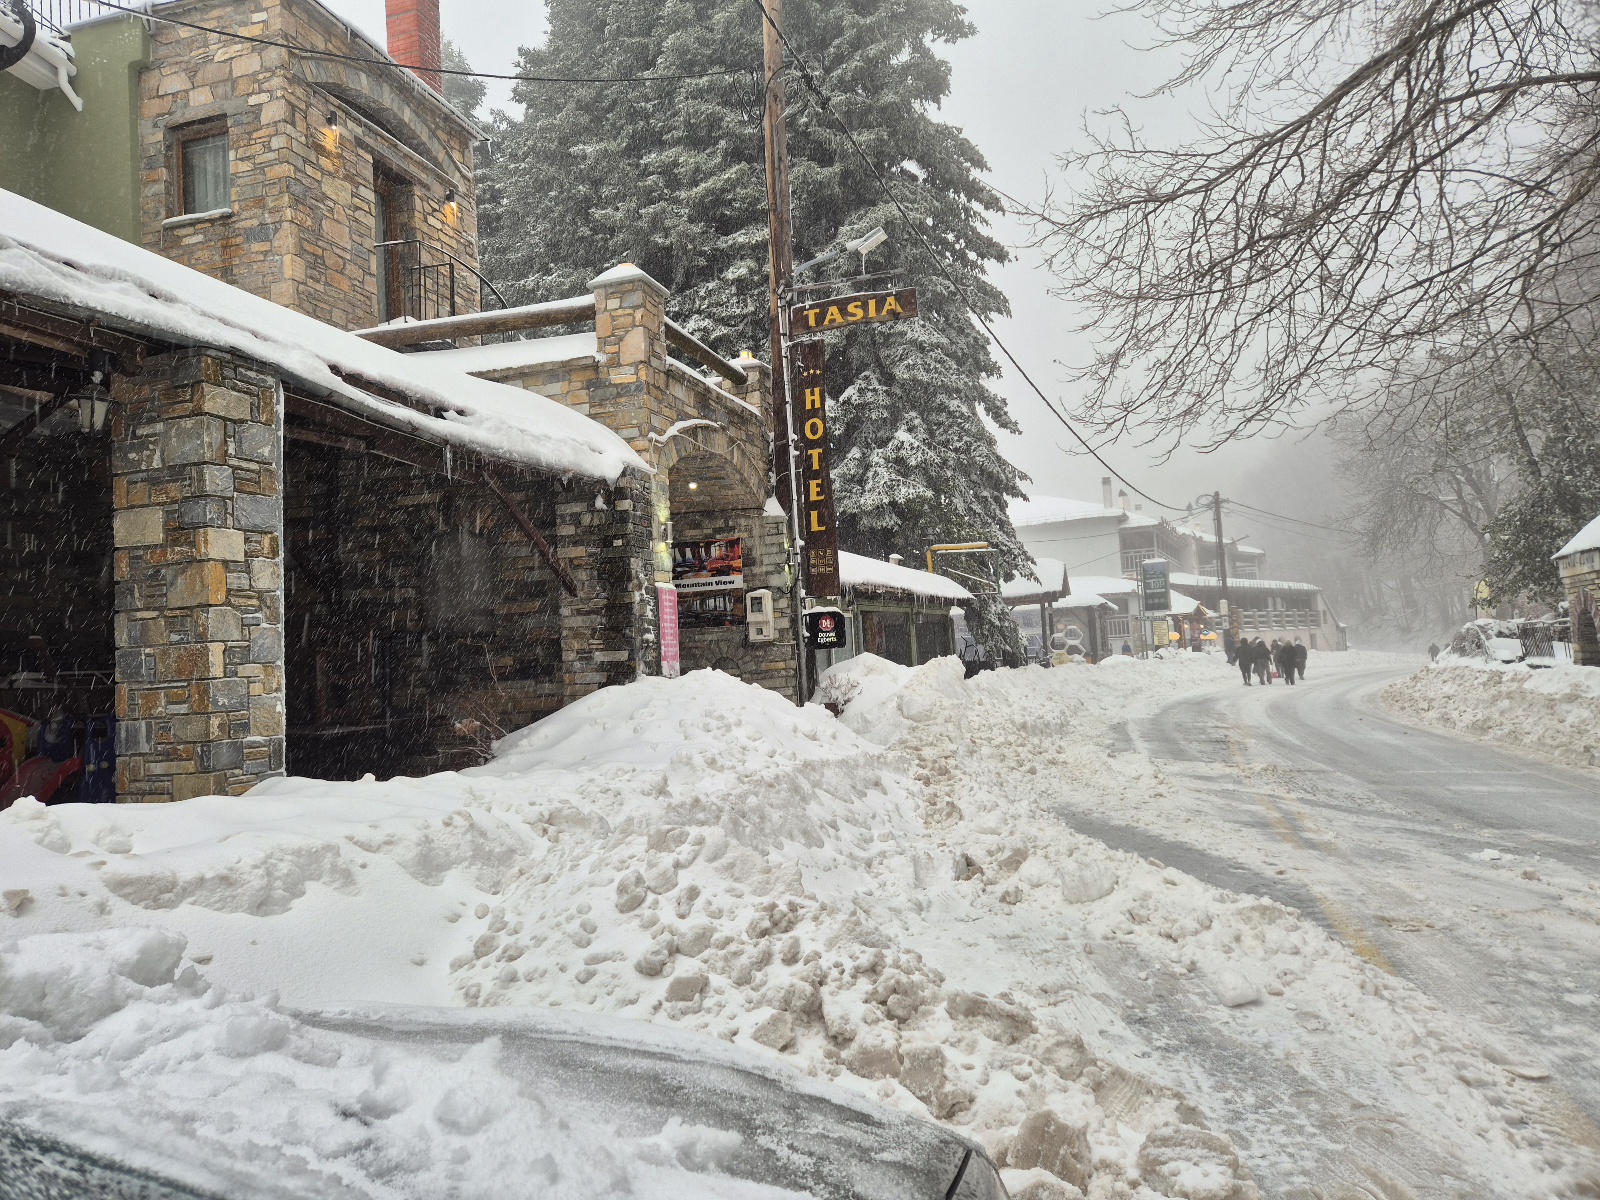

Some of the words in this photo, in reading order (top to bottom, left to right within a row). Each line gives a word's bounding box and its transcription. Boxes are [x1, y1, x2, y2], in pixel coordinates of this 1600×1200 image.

[803, 296, 903, 327] TASIA
[804, 387, 826, 532] HOTEL
[675, 581, 713, 589] Mountain
